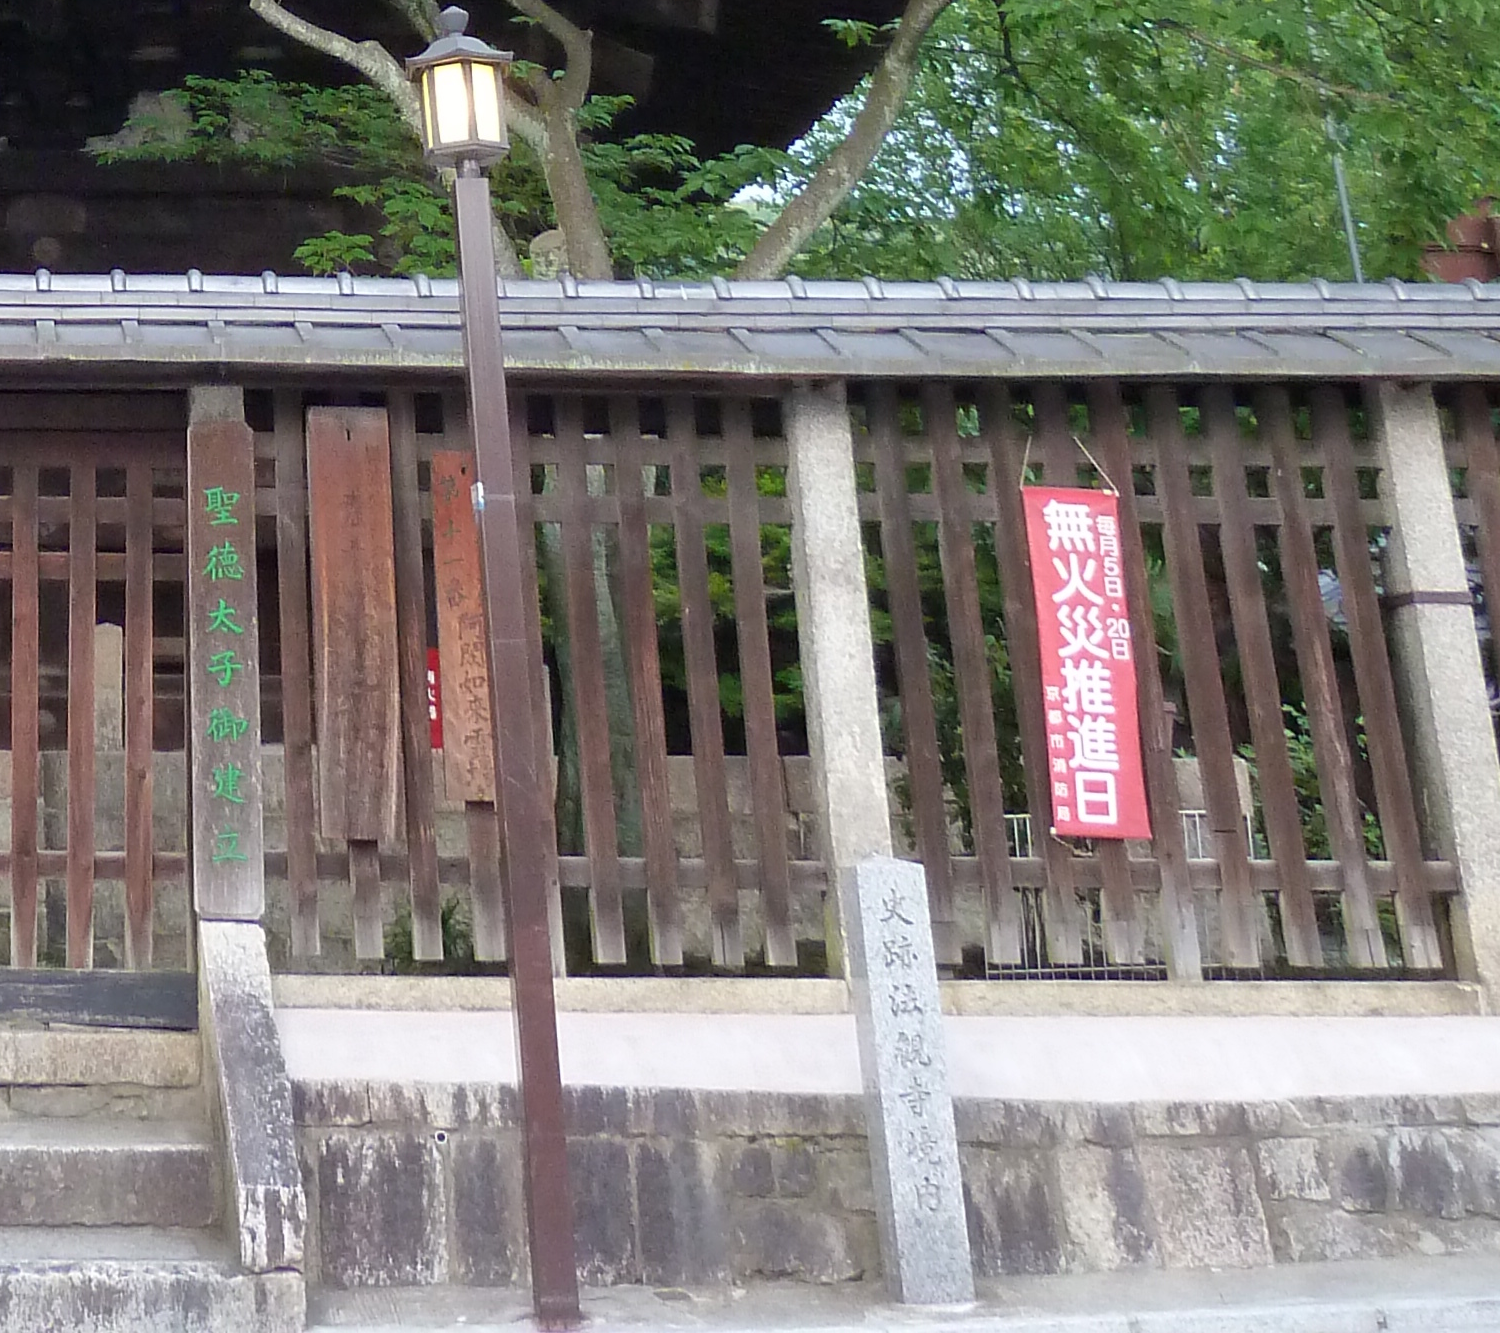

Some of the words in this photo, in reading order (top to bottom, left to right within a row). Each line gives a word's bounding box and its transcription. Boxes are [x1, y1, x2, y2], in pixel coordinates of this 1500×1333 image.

[202, 486, 248, 863] 聖徳太子御建立
[1042, 499, 1120, 825] 無火災推進日
[1045, 686, 1071, 822] 京都市消防局
